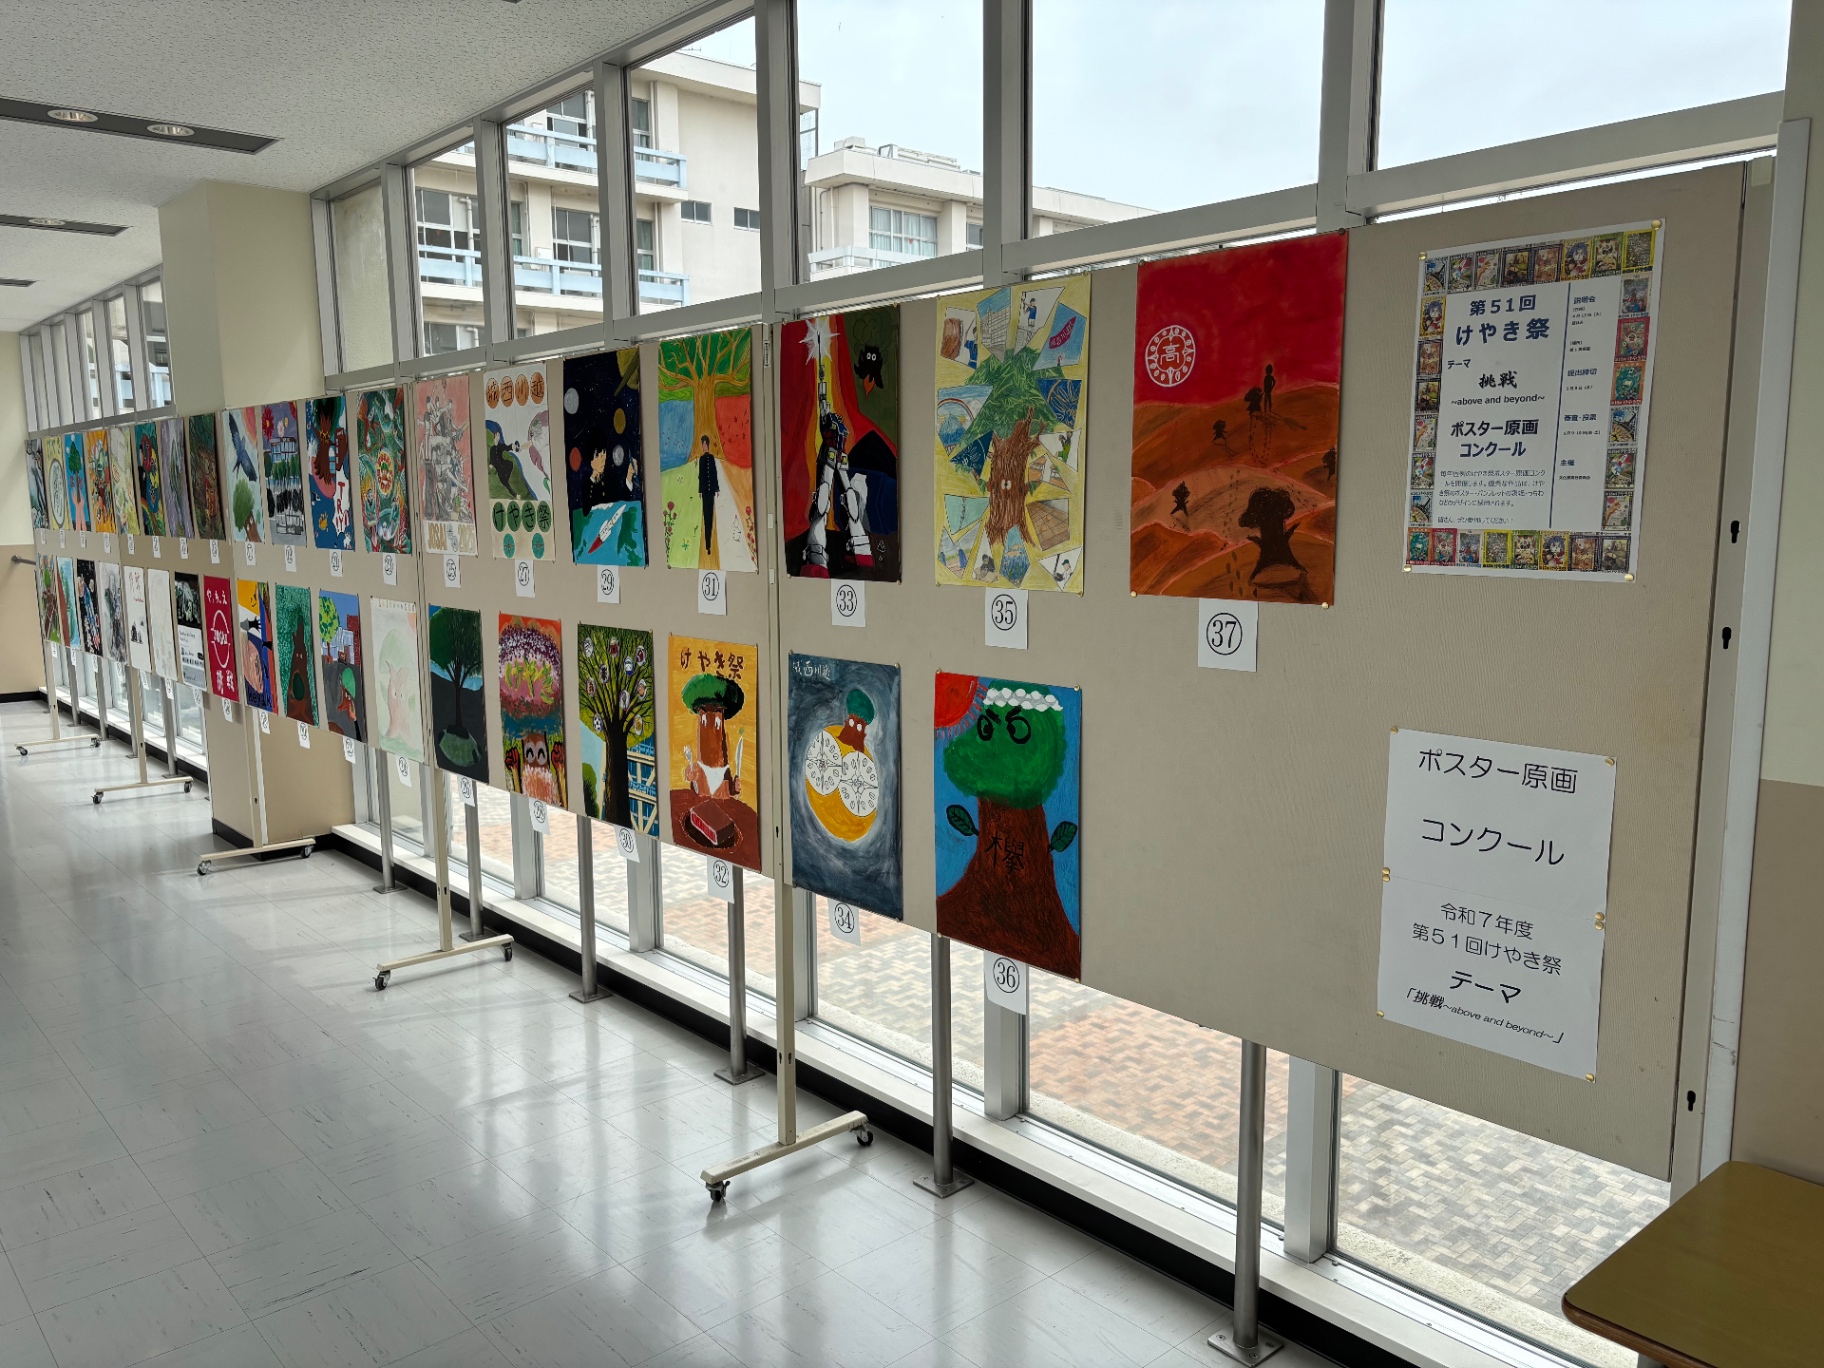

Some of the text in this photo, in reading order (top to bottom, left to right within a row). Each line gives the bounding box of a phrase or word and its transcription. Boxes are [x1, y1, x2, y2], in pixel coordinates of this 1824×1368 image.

[1469, 294, 1537, 317] 第51回
[1455, 317, 1550, 347] けやき祭
[1160, 343, 1181, 365] 高
[1447, 358, 1472, 370] テーマ
[1478, 370, 1518, 389] 挑戦
[1485, 395, 1501, 404] and
[1450, 418, 1540, 438] ポスター原画
[1459, 441, 1527, 458] コンクール
[493, 505, 551, 530] けやき祭
[703, 574, 718, 599] 31
[837, 587, 856, 614] 33
[993, 597, 1015, 627] 35
[1208, 616, 1240, 652] 37
[680, 648, 745, 680] けやき祭
[505, 657, 555, 705] けやき
[1418, 747, 1579, 794] ポスター原画
[1422, 818, 1564, 866] コンクール
[714, 862, 728, 885] 32
[836, 905, 853, 930] 34
[1440, 902, 1535, 940] 令和7年度
[1412, 922, 1563, 976] 第51回けやき祭
[995, 960, 1018, 990] 36
[1449, 970, 1522, 1004] テーマ
[1483, 1014, 1504, 1027] and
